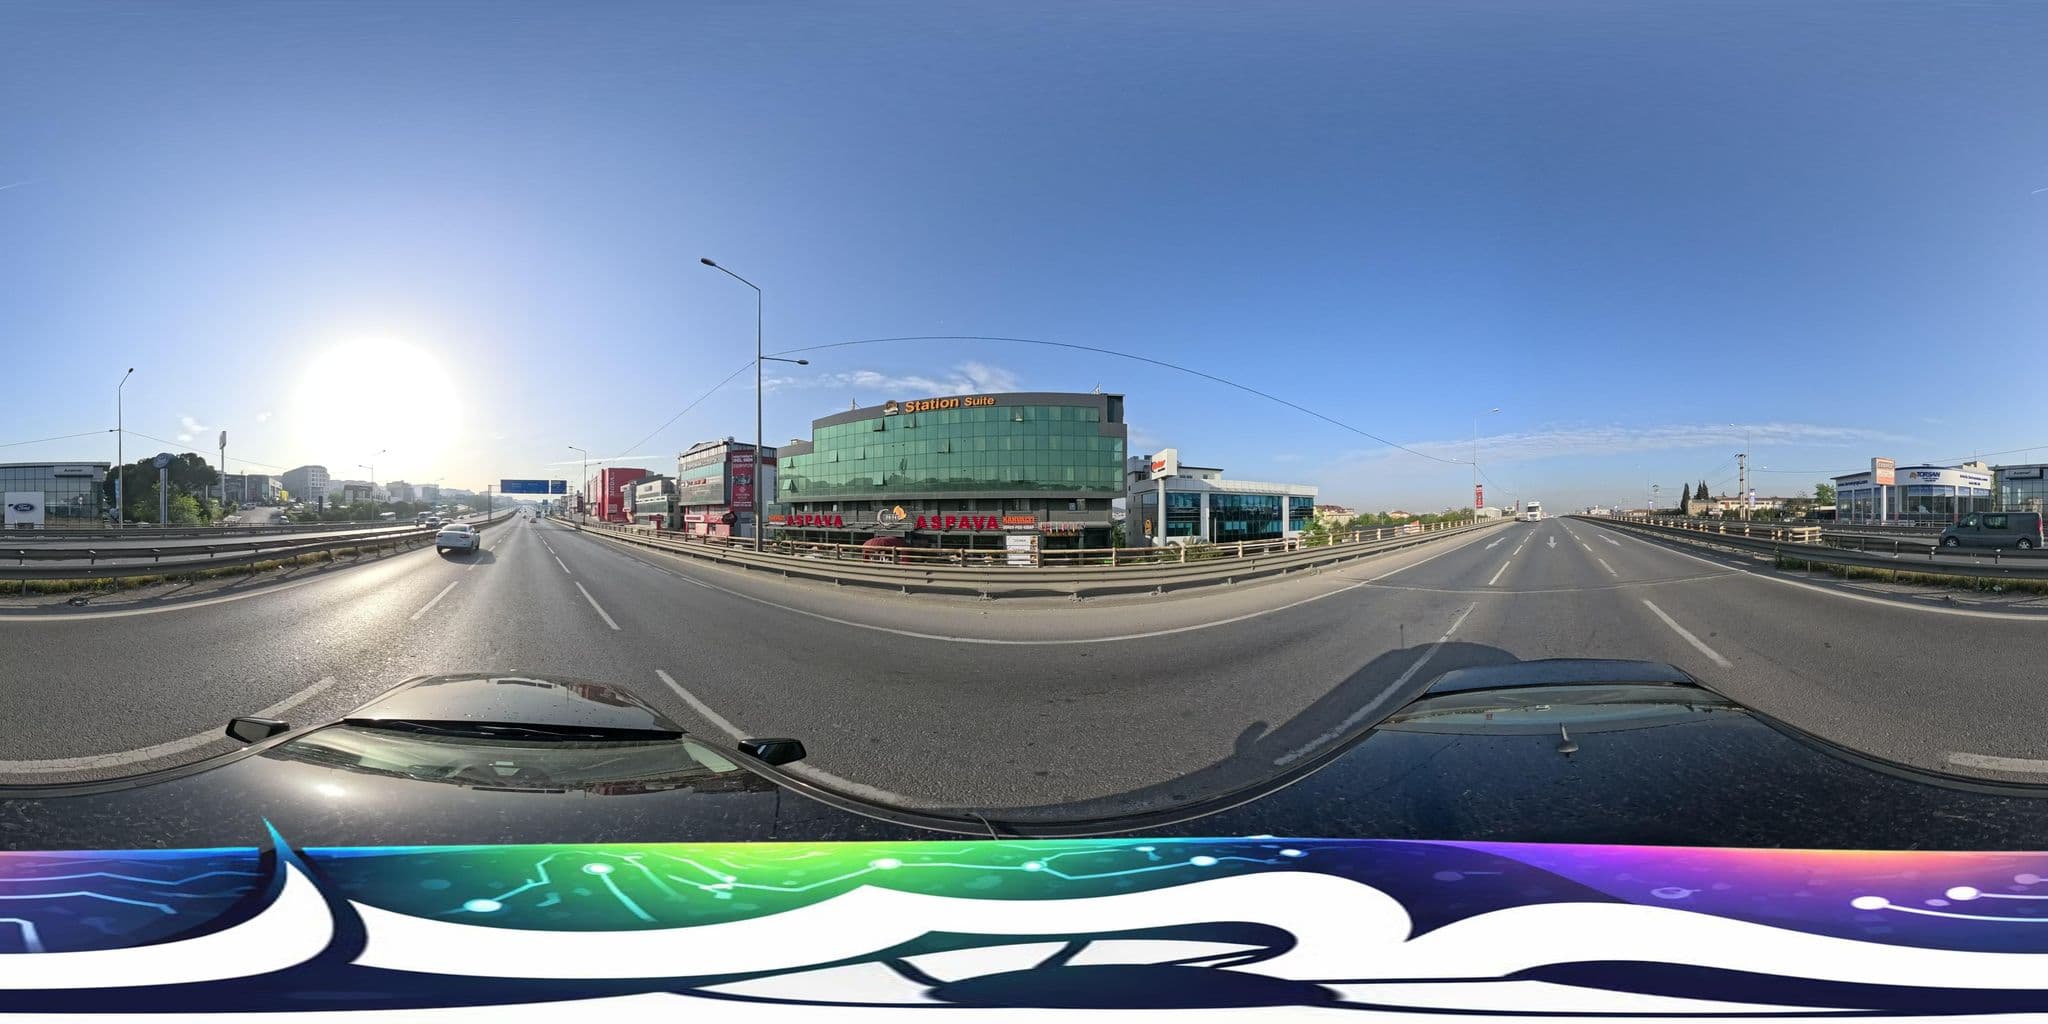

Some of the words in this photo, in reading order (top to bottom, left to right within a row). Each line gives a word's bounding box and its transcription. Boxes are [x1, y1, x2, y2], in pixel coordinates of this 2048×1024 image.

[904, 398, 959, 413] Station
[963, 396, 995, 406] Suite
[785, 514, 844, 528] ASPAVA
[915, 513, 1000, 530] ASPAVA
